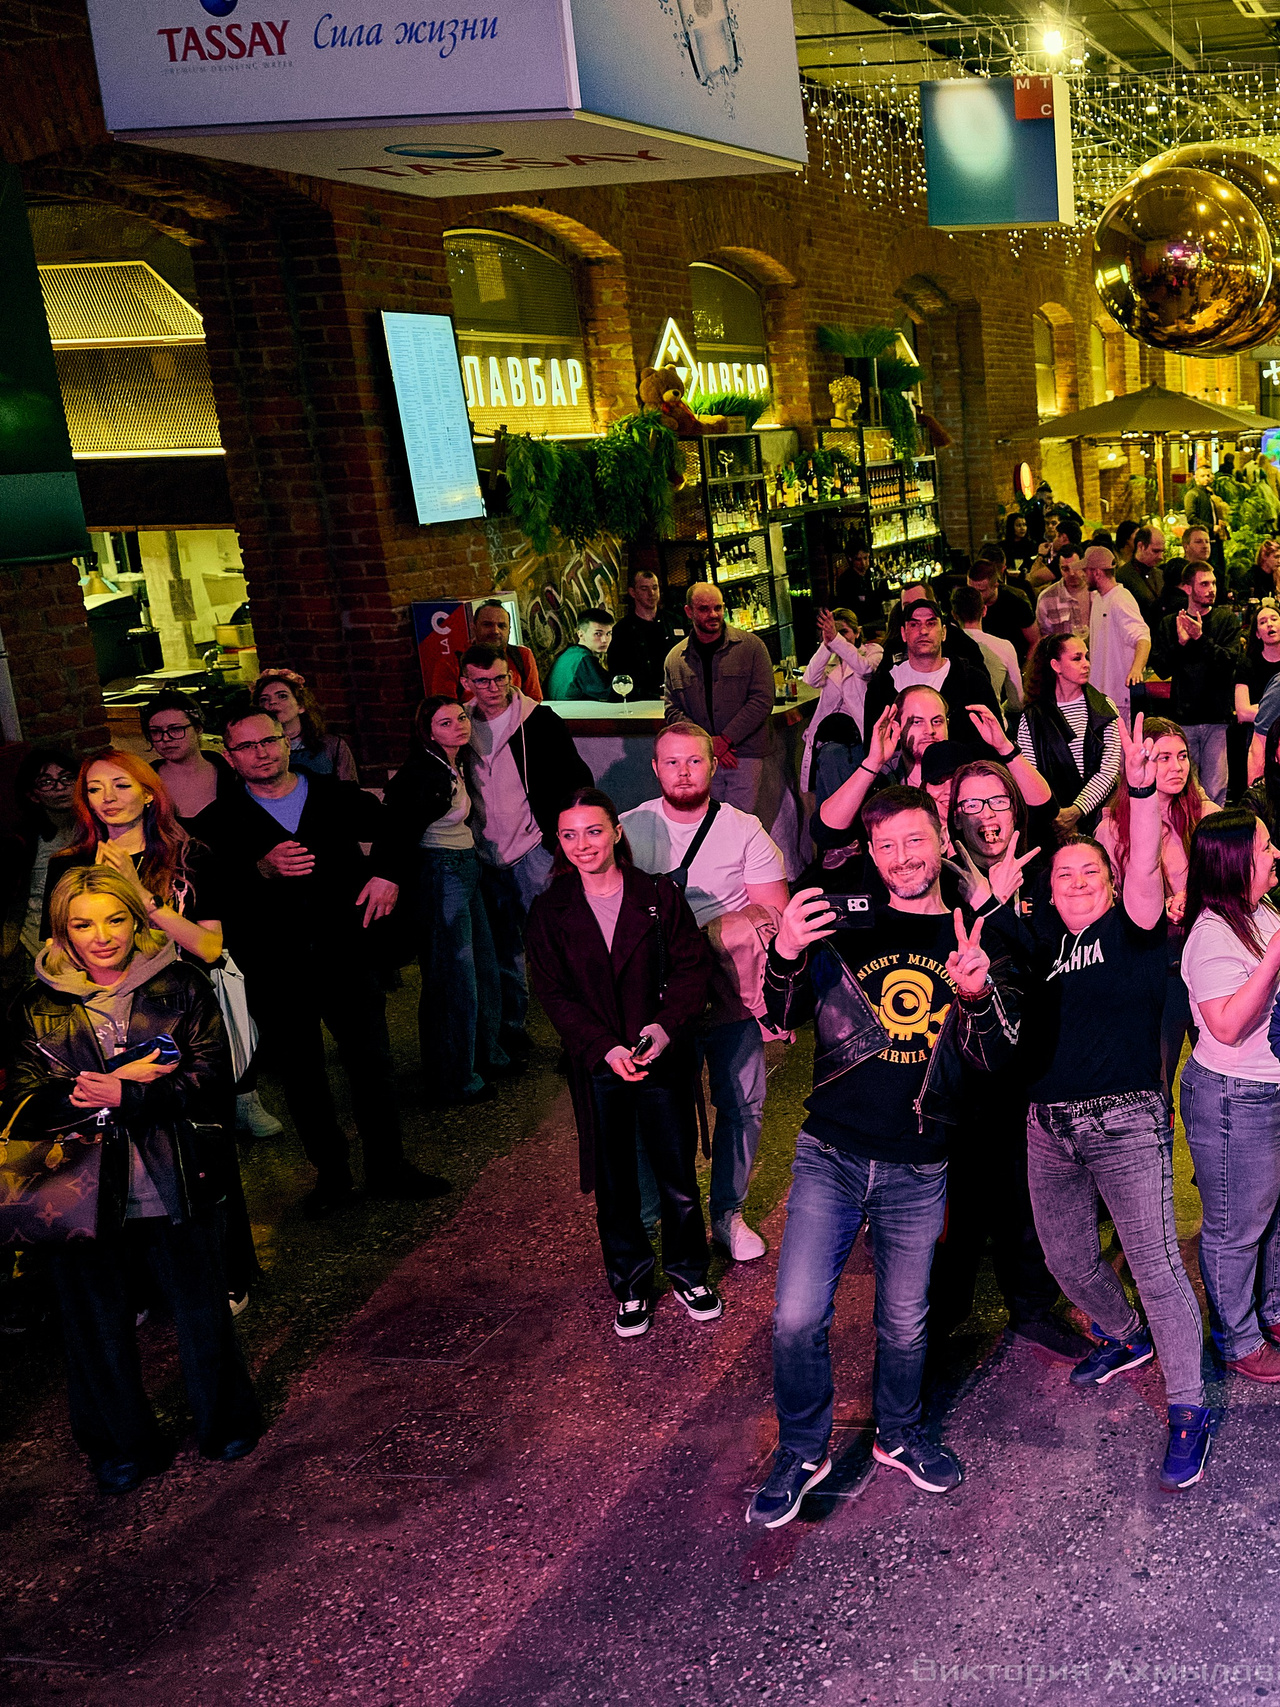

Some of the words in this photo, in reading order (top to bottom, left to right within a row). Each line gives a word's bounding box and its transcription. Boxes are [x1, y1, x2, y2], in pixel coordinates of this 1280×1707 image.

[157, 20, 291, 63] TASSAY
[313, 13, 384, 49] Сила
[395, 15, 499, 59] жизни
[337, 150, 666, 177] TASSAY
[856, 953, 900, 981] NIGHT
[877, 1049, 928, 1064] ARNIA
